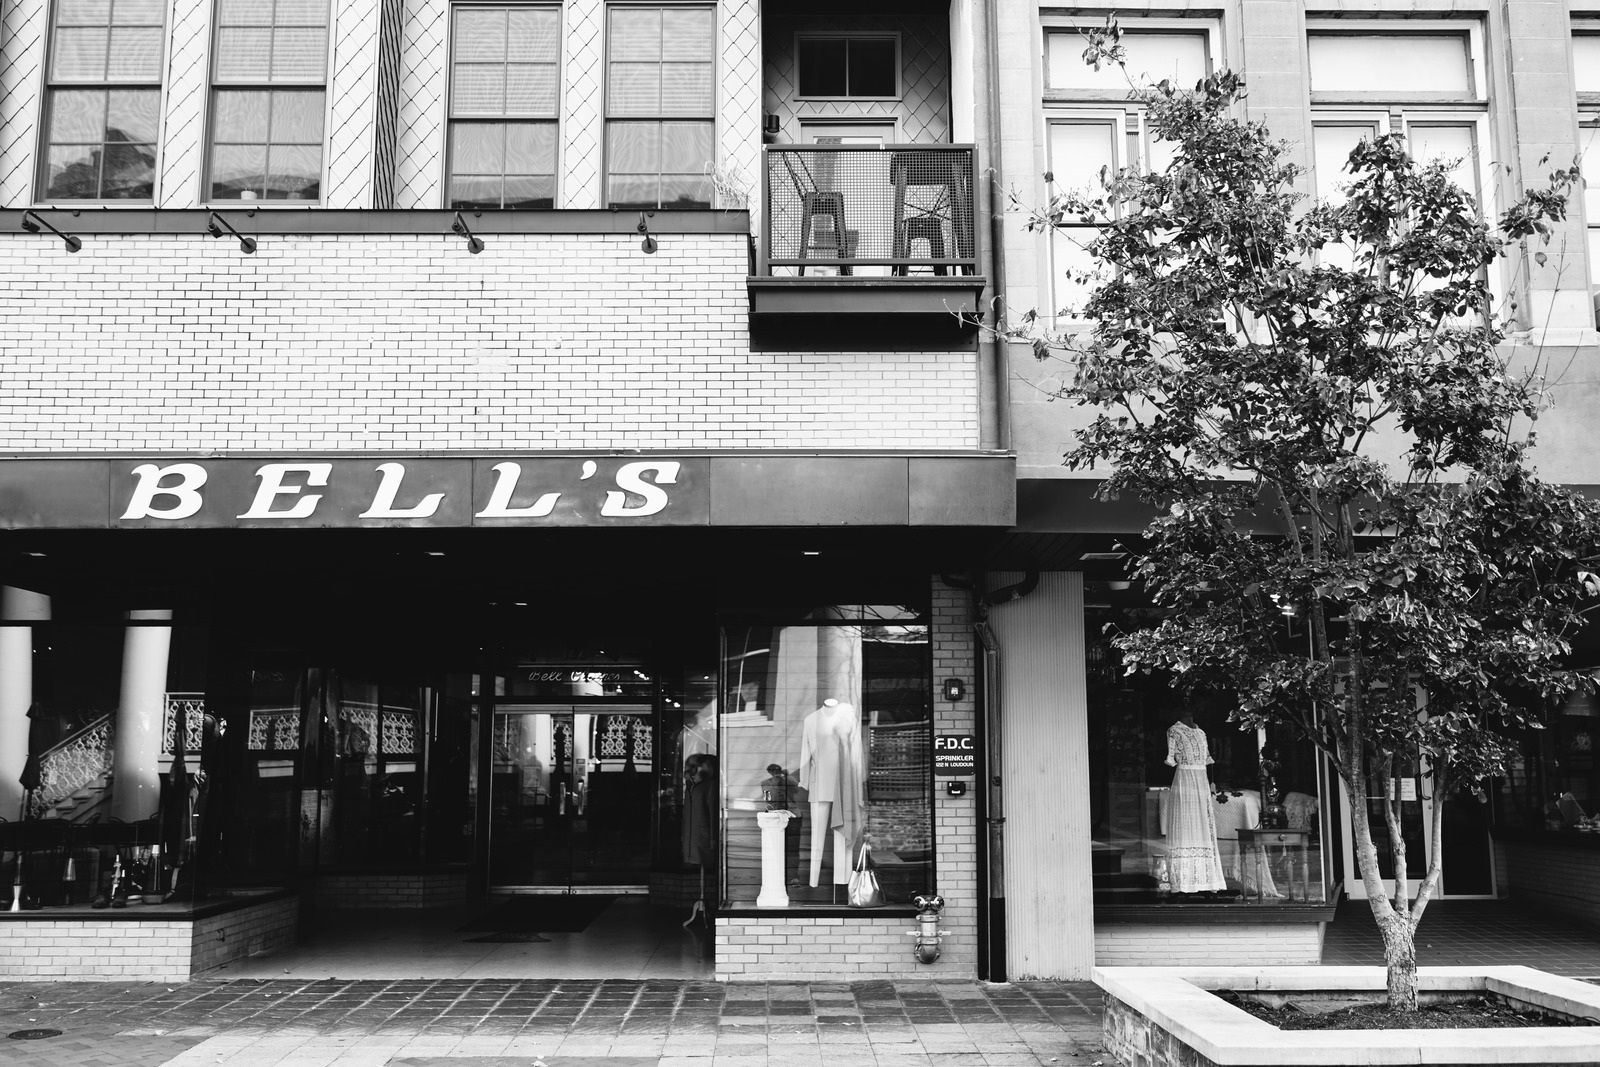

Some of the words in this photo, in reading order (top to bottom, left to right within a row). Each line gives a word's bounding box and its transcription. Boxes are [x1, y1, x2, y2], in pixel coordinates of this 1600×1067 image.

[119, 460, 681, 520] BELL'S
[528, 669, 563, 682] Bell
[935, 738, 974, 750] F.D.C.
